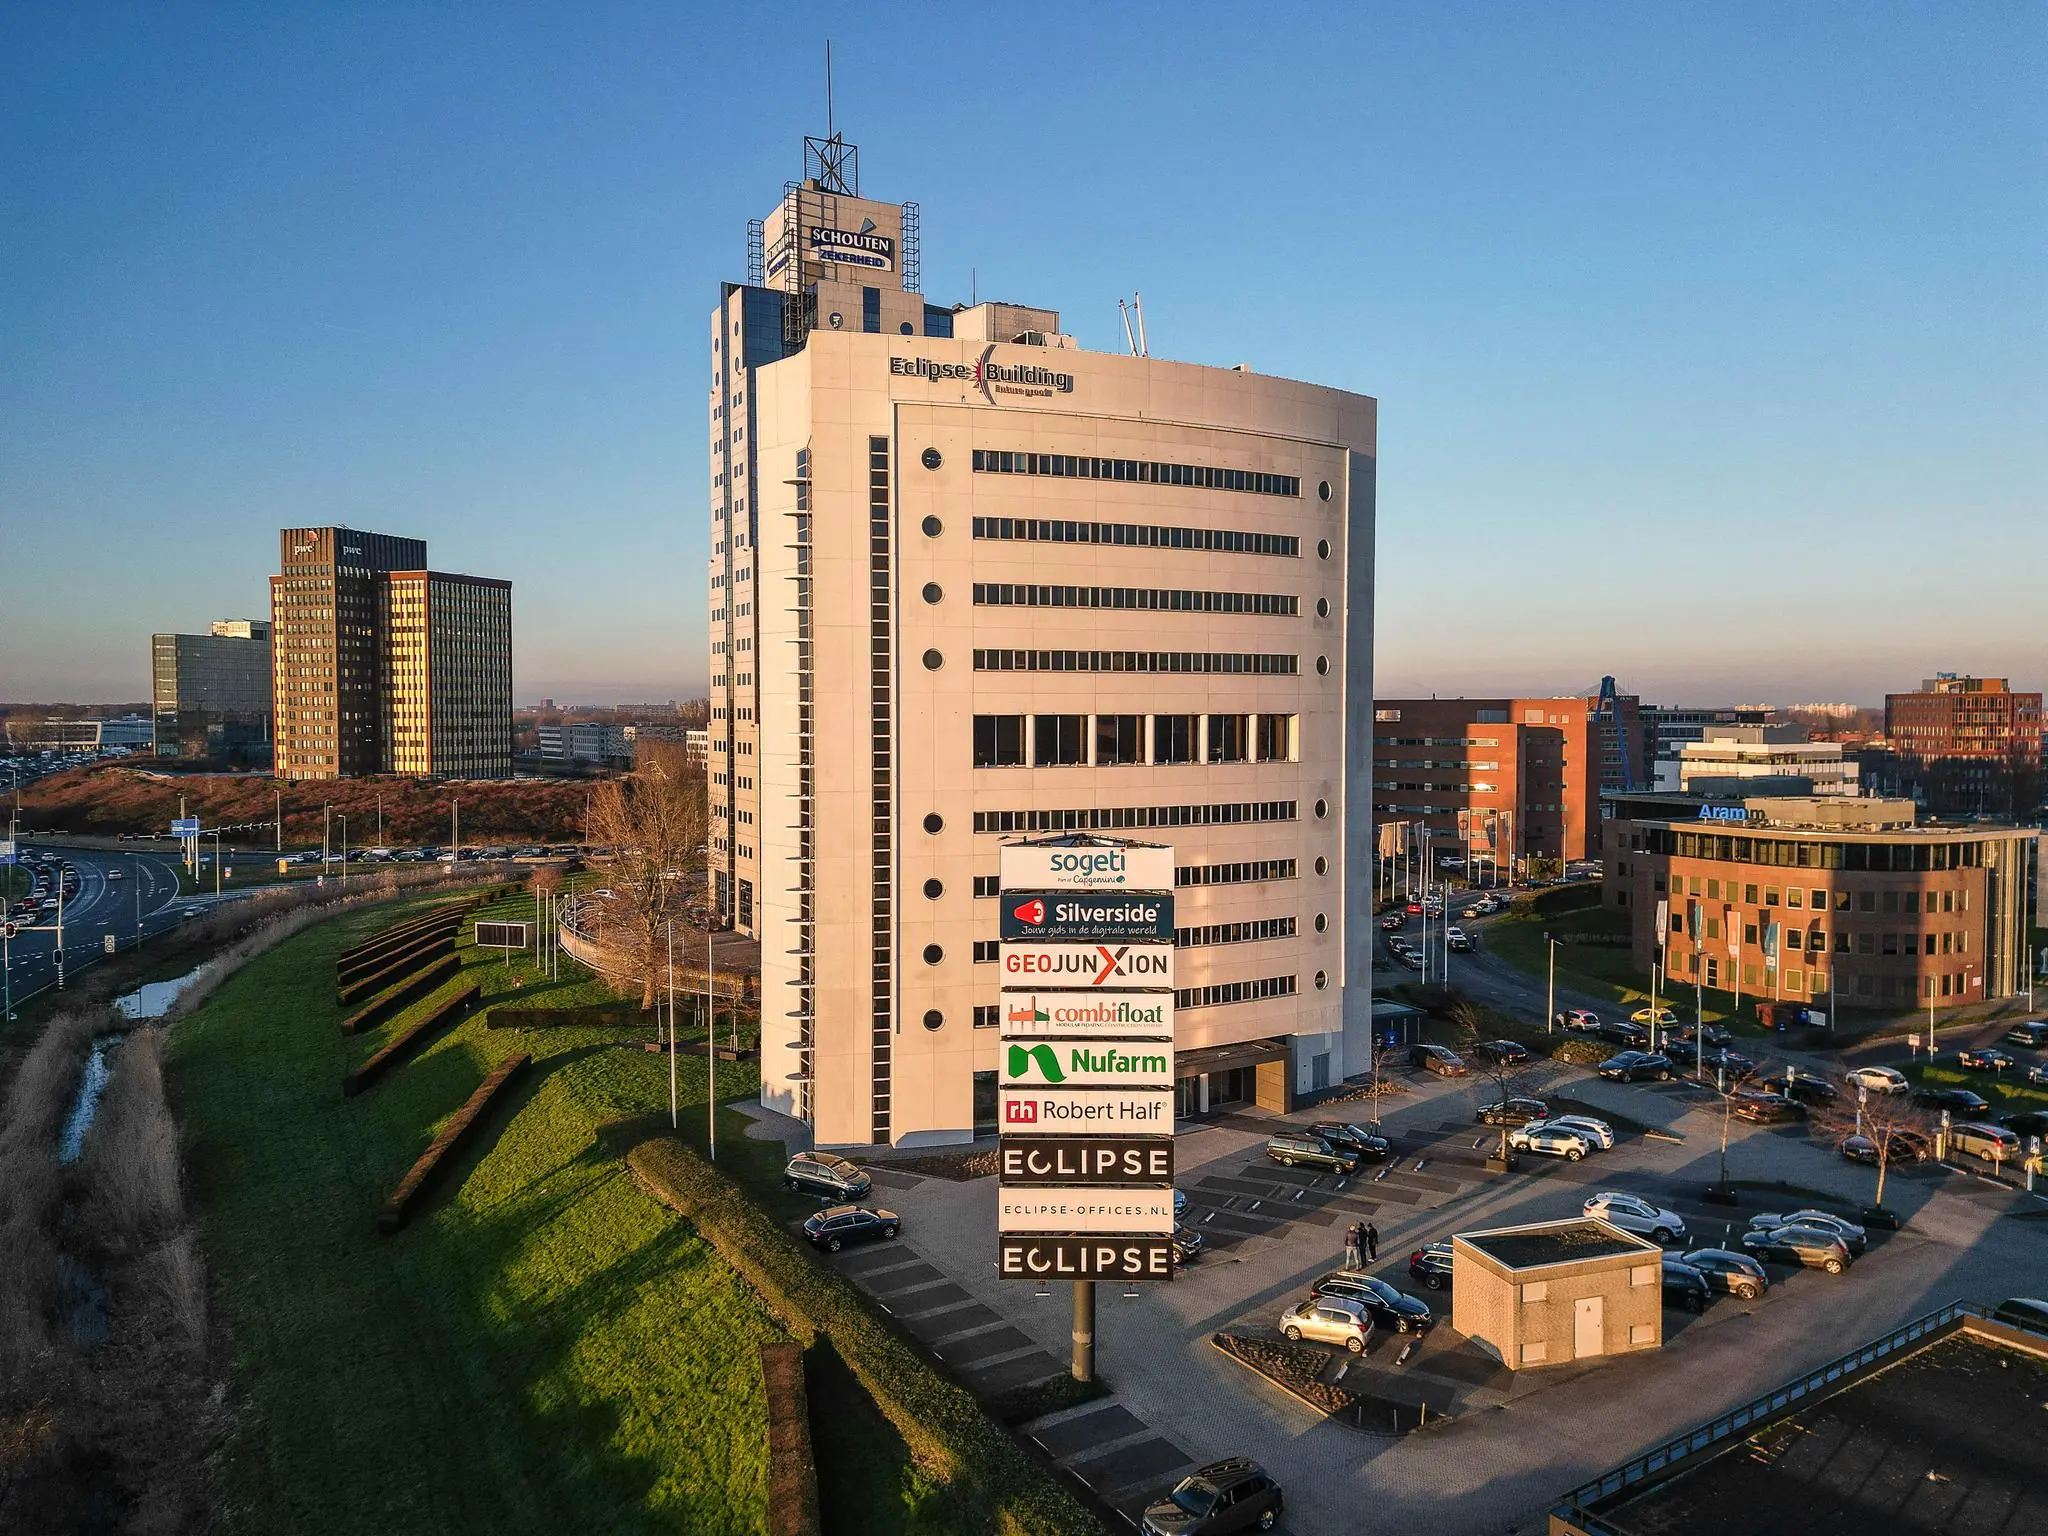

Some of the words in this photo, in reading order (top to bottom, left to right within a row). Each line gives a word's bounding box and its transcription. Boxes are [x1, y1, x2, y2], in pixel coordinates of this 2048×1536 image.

[812, 228, 889, 251] SCHOUTEN
[819, 249, 885, 267] ZEKERHEID
[889, 356, 967, 382] Eclipse
[985, 363, 1070, 392] Building
[294, 545, 313, 556] pwc
[343, 545, 362, 555] pwc
[1050, 848, 1126, 876] sogeti
[1073, 875, 1116, 886] Capgemini
[1055, 903, 1158, 923] Silverside
[1021, 925, 1046, 935] Jouw
[1047, 925, 1066, 937] gids
[1068, 925, 1077, 934] in
[1078, 925, 1089, 934] de
[1091, 925, 1125, 937] digitale
[1127, 925, 1157, 935] wereld
[1006, 946, 1167, 985] GEOJUNXION
[1054, 1001, 1163, 1023] combifloat
[1071, 1049, 1167, 1073] Nufarm
[1043, 1101, 1114, 1120] Robert
[1004, 1149, 1168, 1175] ECLIPSE
[1004, 1205, 1169, 1216] ECLIPSE-OFFICES.NL
[1003, 1247, 1168, 1273] ECLIPSE
